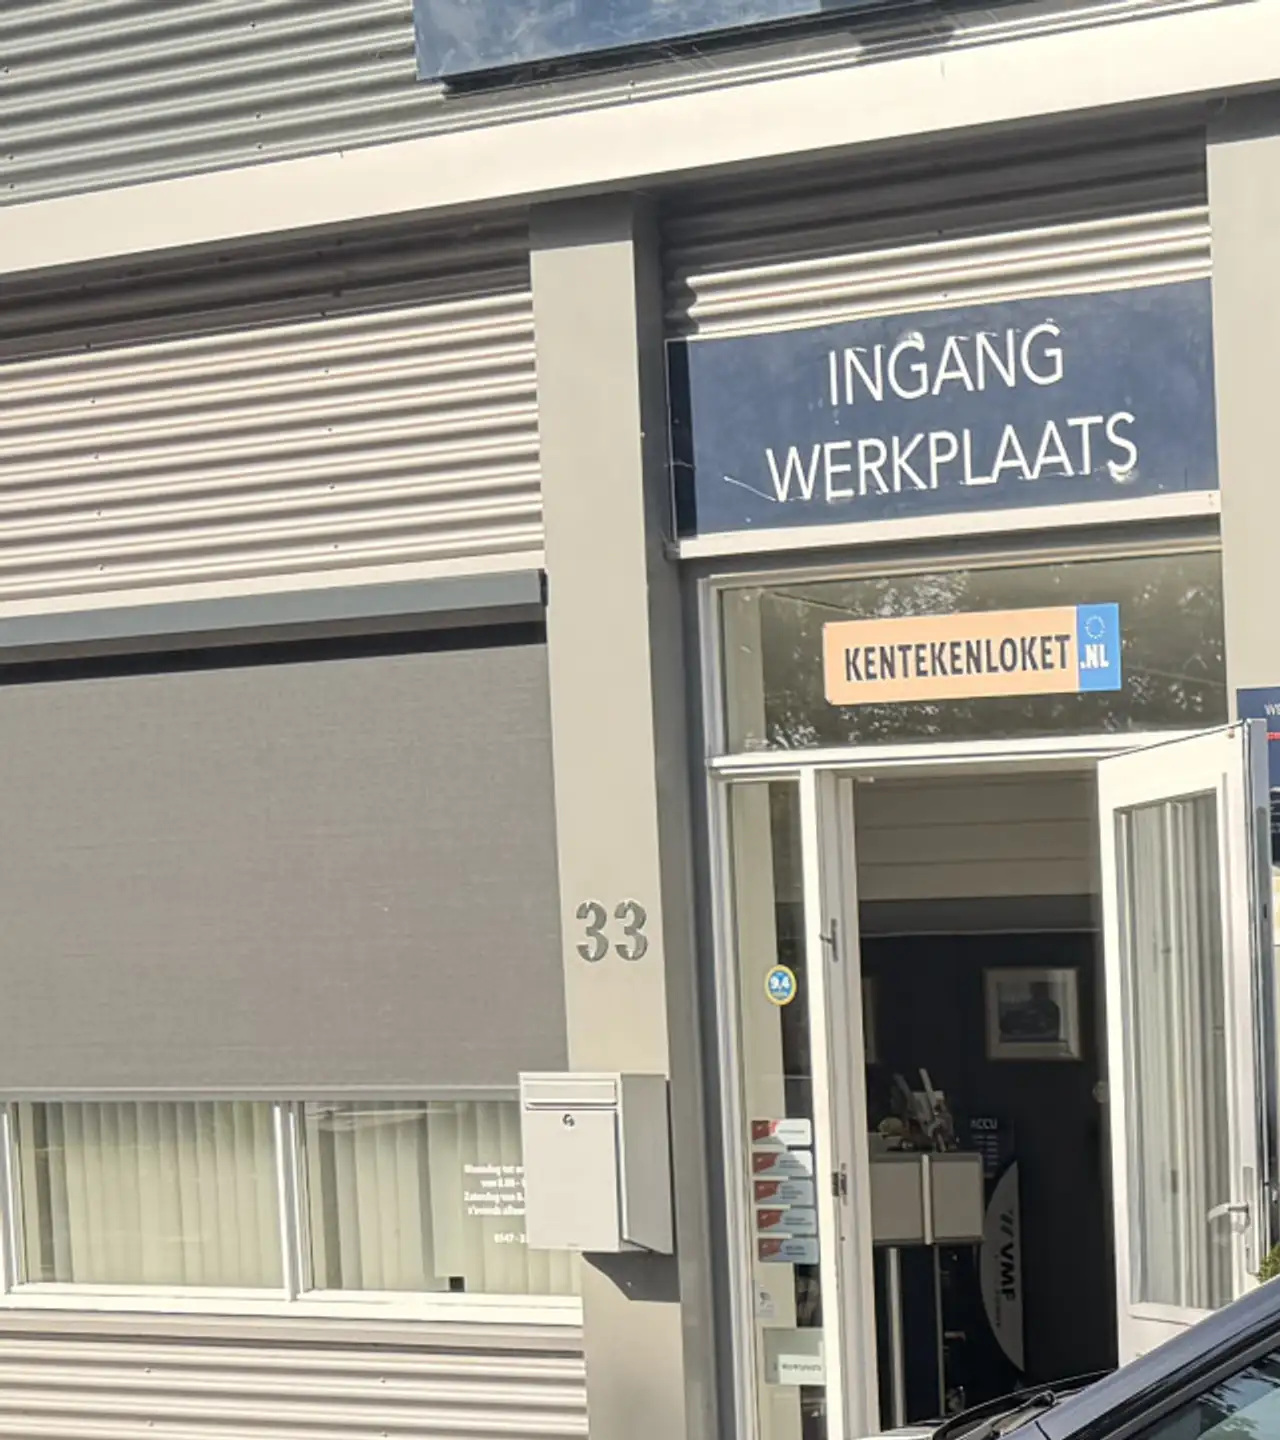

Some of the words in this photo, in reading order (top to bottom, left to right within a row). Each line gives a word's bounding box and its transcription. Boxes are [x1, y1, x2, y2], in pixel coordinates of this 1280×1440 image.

[828, 322, 1065, 406] INGANG
[765, 411, 1139, 503] WERKPLAATS
[844, 632, 1071, 682] KENTEKENLOKET
[575, 899, 648, 962] 33
